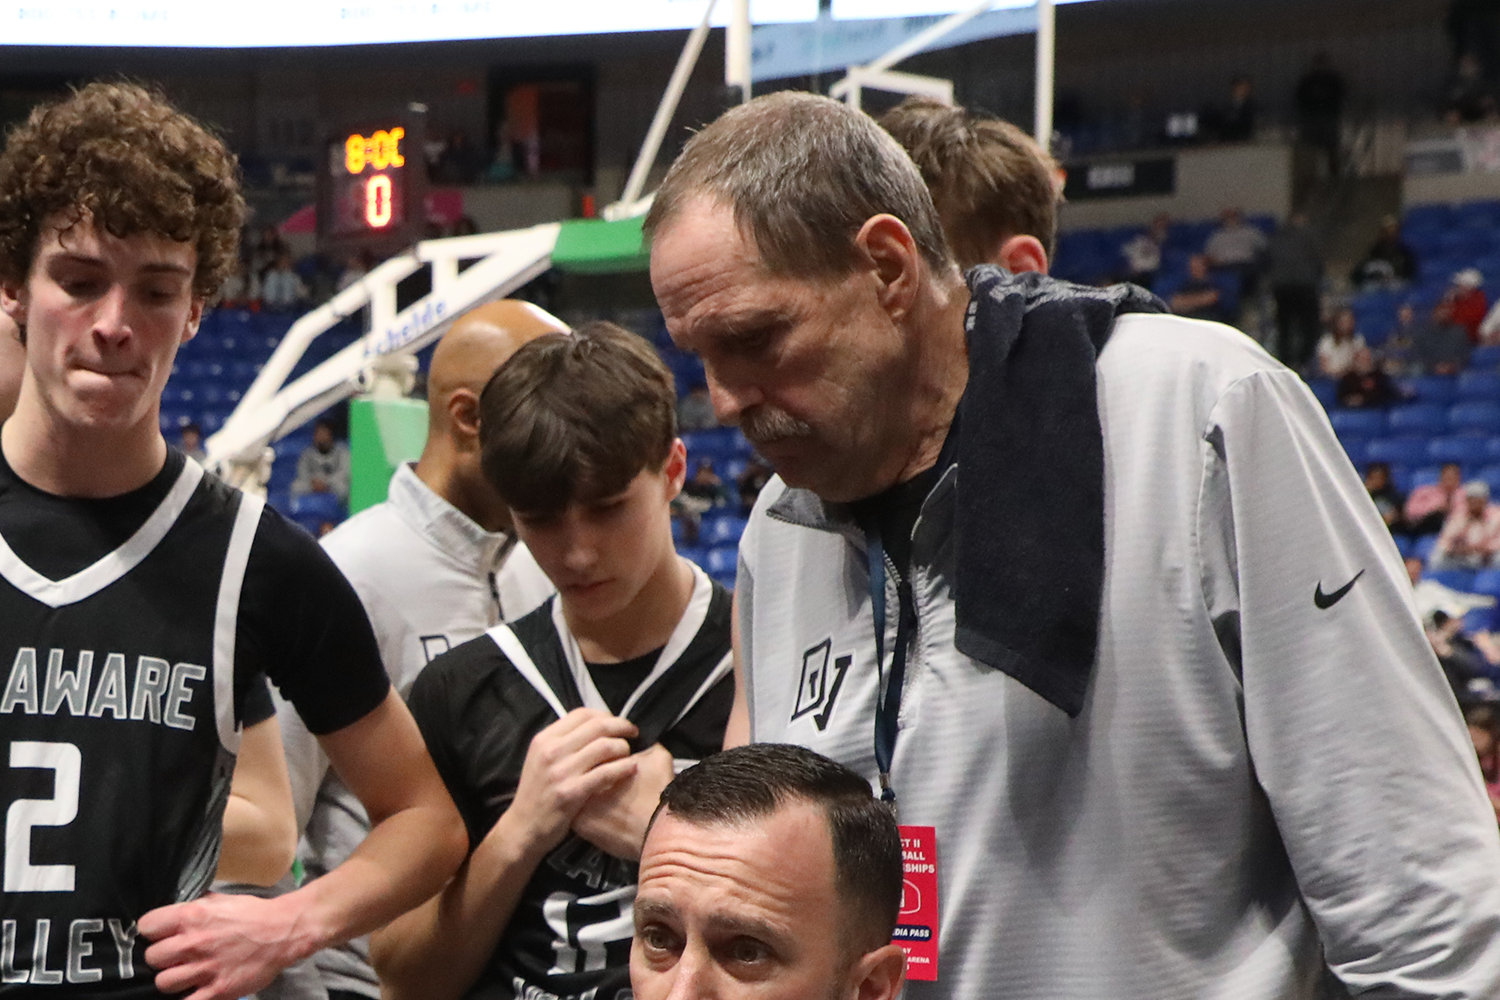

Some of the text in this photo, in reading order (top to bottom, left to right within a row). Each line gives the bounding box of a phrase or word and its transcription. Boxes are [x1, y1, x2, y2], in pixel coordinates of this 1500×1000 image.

[366, 174, 391, 227] 0
[3, 740, 83, 893] 2
[909, 928, 930, 938] PASS
